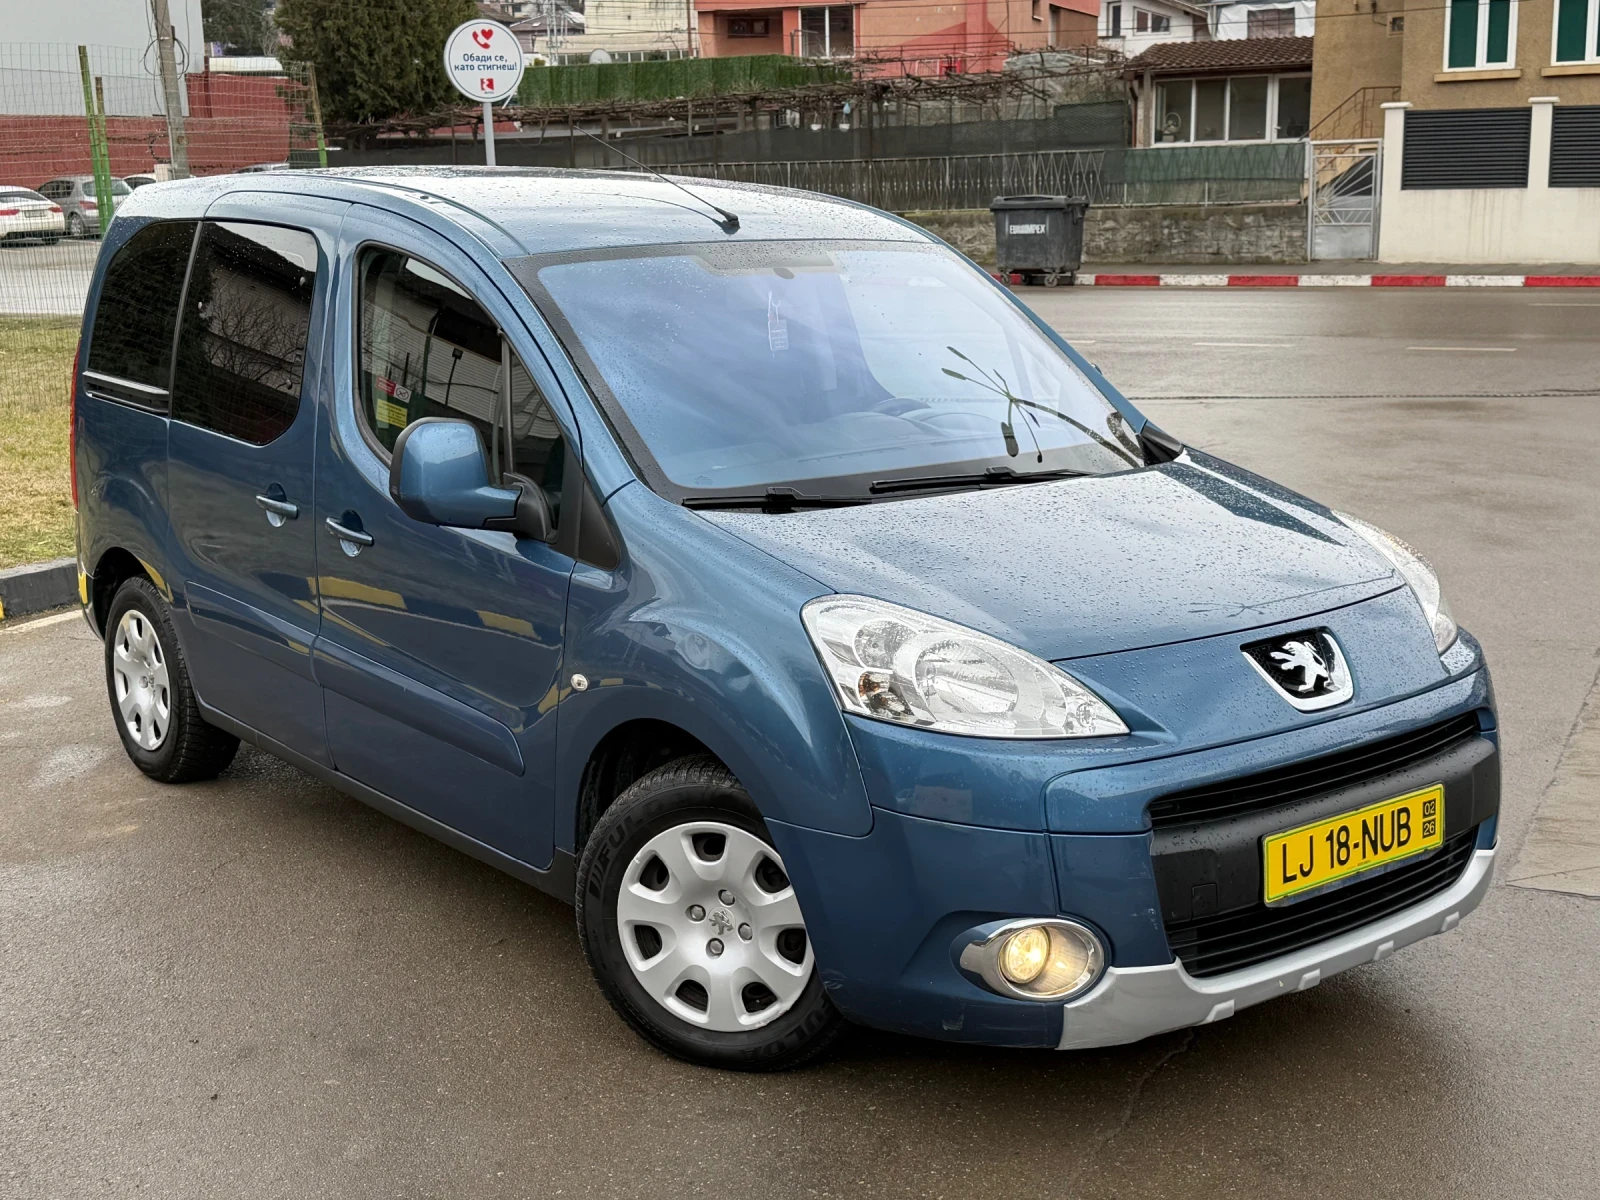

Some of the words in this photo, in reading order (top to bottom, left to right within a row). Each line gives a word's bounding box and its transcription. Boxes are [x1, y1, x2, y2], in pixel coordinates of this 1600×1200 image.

[463, 53, 492, 62] Обади
[478, 62, 517, 70] стигнеш!
[1424, 801, 1436, 815] 02
[1423, 821, 1435, 836] 26
[1282, 835, 1314, 884] LJ
[1325, 807, 1411, 869] 18-NUB
